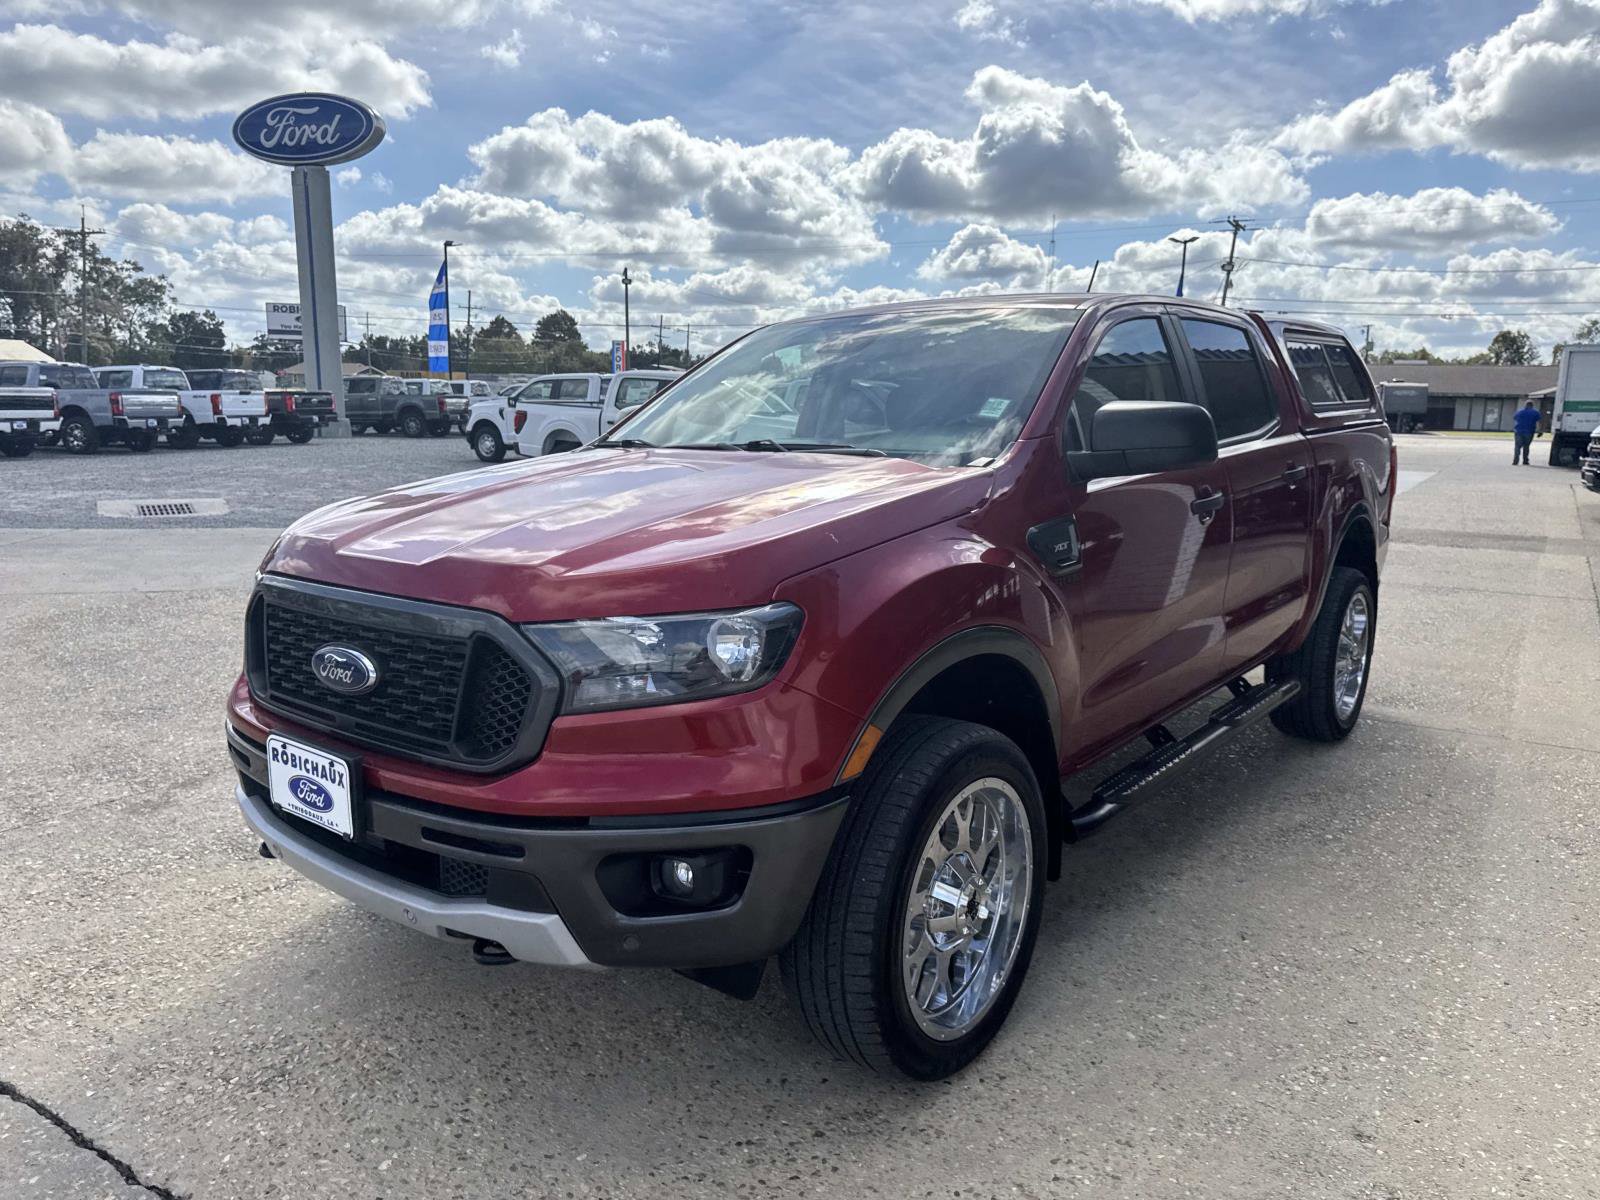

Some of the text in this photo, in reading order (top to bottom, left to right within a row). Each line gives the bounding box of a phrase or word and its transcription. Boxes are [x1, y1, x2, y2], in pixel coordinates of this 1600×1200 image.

[260, 106, 342, 148] Ford
[272, 304, 302, 314] ROBI
[320, 653, 355, 684] Ford
[271, 746, 345, 789] ROBICHAUX
[297, 780, 325, 808] Ford
